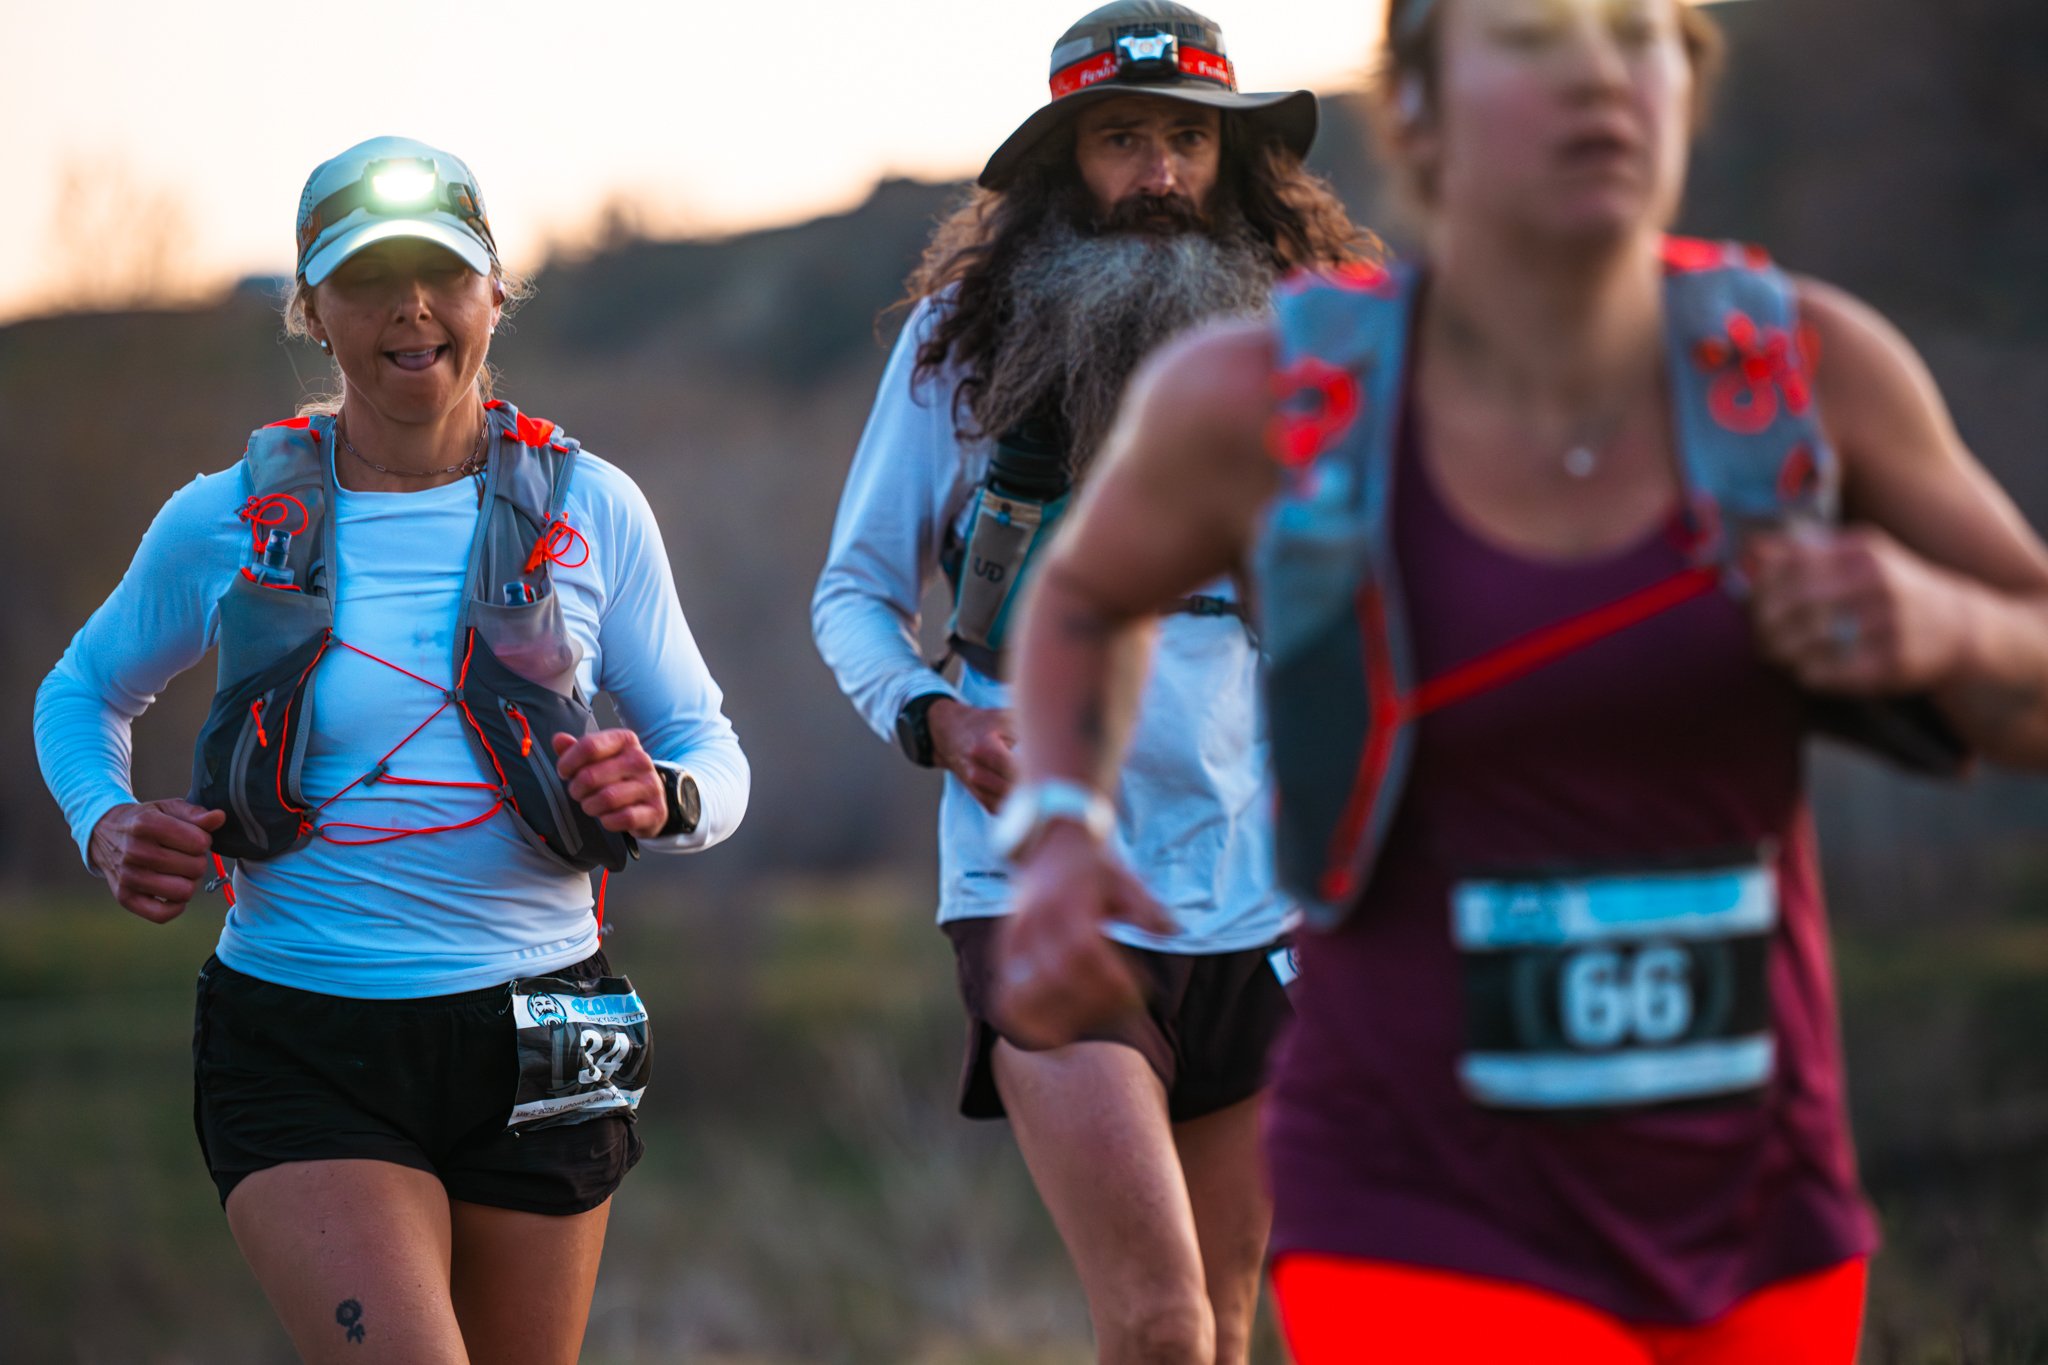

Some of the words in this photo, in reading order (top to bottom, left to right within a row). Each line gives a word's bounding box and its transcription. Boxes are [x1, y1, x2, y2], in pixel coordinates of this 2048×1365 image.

[974, 555, 1005, 583] UD
[1563, 945, 1691, 1046] 66
[578, 1029, 630, 1084] 34
